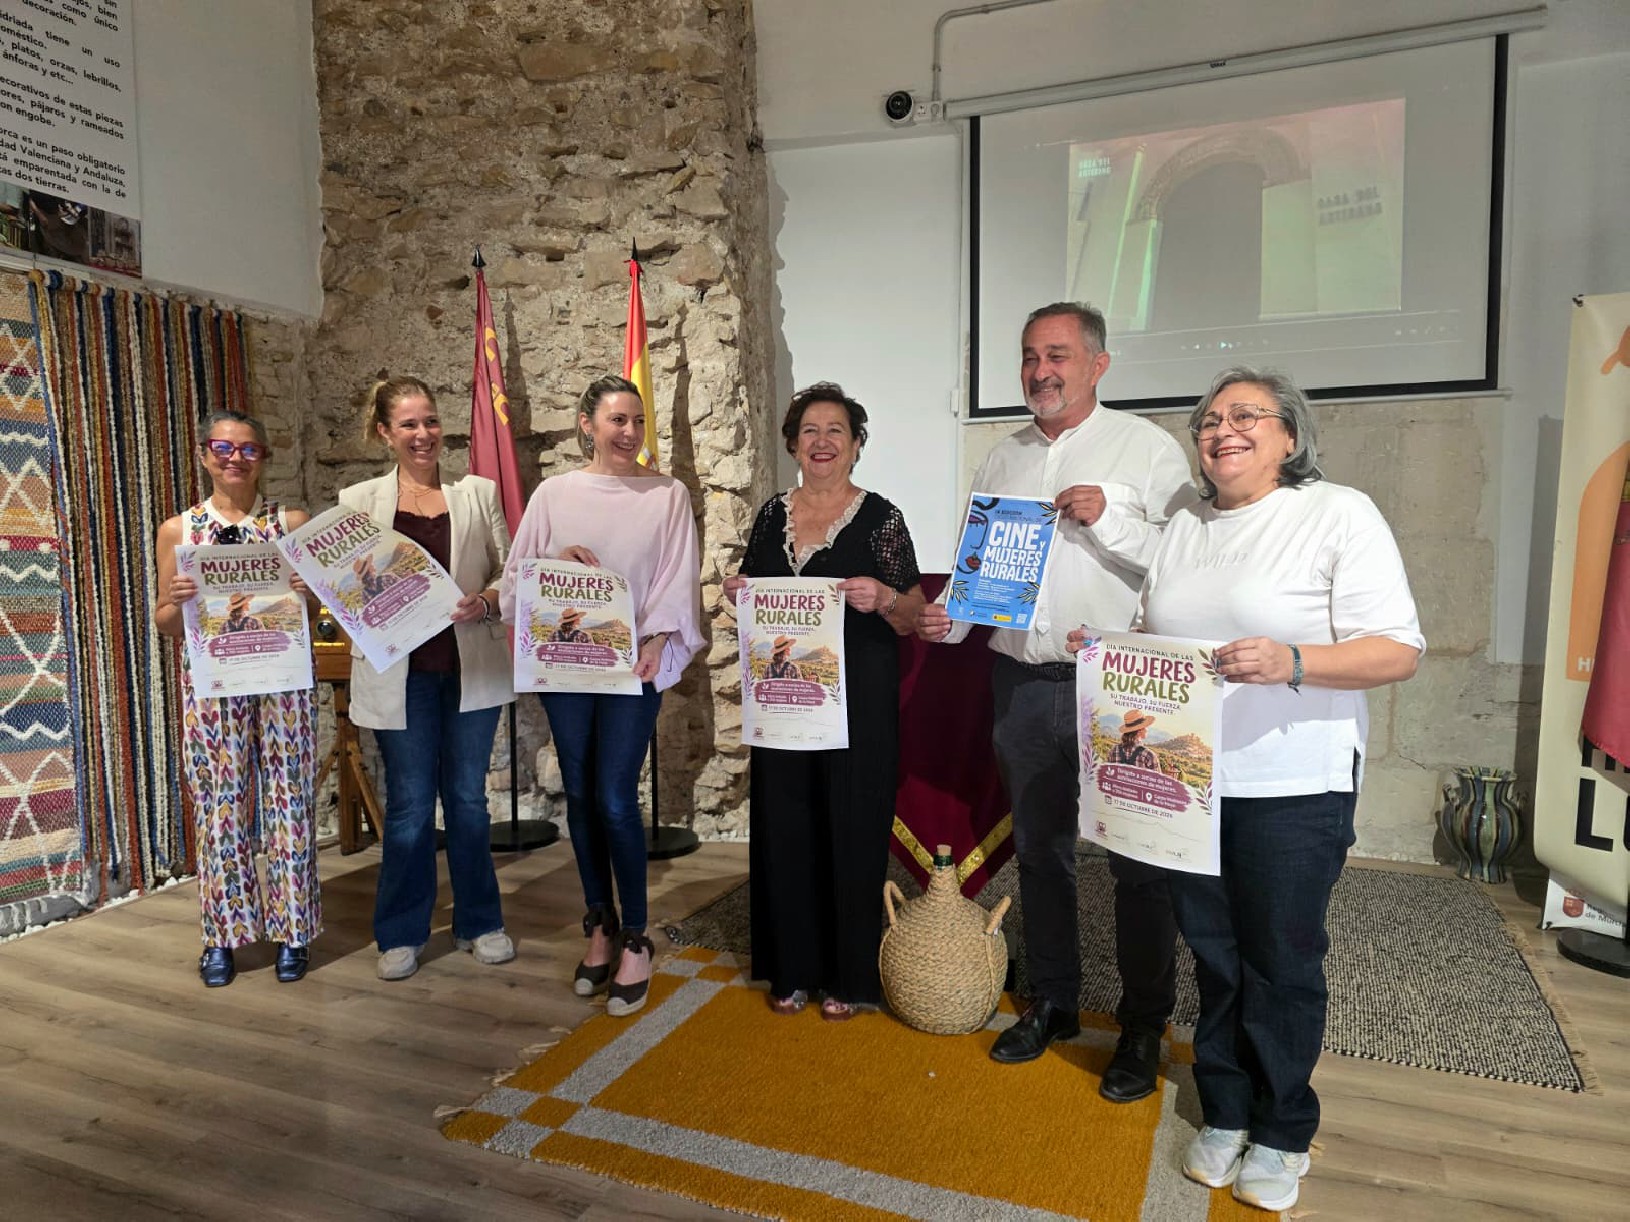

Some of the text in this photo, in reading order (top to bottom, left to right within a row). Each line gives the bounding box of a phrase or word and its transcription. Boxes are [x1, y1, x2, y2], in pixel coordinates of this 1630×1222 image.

[62, 3, 86, 18] como
[94, 15, 118, 31] único
[97, 4, 117, 20] bien
[45, 31, 69, 46] tiene
[82, 46, 93, 57] un
[104, 57, 120, 68] uso
[2, 50, 39, 71] ánforas
[41, 67, 47, 77] y
[11, 41, 121, 92] platos, orzas, lebrillos,
[15, 107, 56, 127] engobe.
[31, 100, 66, 118] pájaros
[70, 115, 76, 124] y
[81, 119, 124, 139] rameados
[53, 94, 66, 106] de
[69, 102, 92, 117] estas
[96, 113, 123, 128] piezas
[20, 144, 71, 169] Valenciana
[74, 164, 80, 174] y
[83, 167, 125, 187] Andaluza.
[22, 135, 32, 144] es
[36, 140, 48, 149] un
[51, 145, 74, 158] paso
[77, 151, 125, 175] obligatorio
[14, 158, 77, 184] emparentada
[82, 180, 97, 190] con
[102, 184, 111, 194] la
[115, 189, 126, 198] de
[15, 170, 32, 182] dos
[35, 176, 69, 193] tierras.
[306, 512, 370, 558] MUJERES
[317, 522, 380, 567] RURALES
[988, 520, 1041, 550] CINE
[201, 557, 281, 574] MUJERES
[983, 545, 1042, 567] MUJERES
[204, 570, 279, 586] RURALES
[539, 572, 614, 591] MUJERES
[980, 560, 1038, 583] RURALES
[541, 585, 612, 602] RURALES
[754, 593, 825, 612] MUJERES
[755, 608, 822, 626] RURALES
[1119, 645, 1168, 657] INTERNACIONAL
[1102, 651, 1196, 683] MUJERES
[1103, 671, 1190, 704] RURALES
[1114, 700, 1143, 710] NUESTRO
